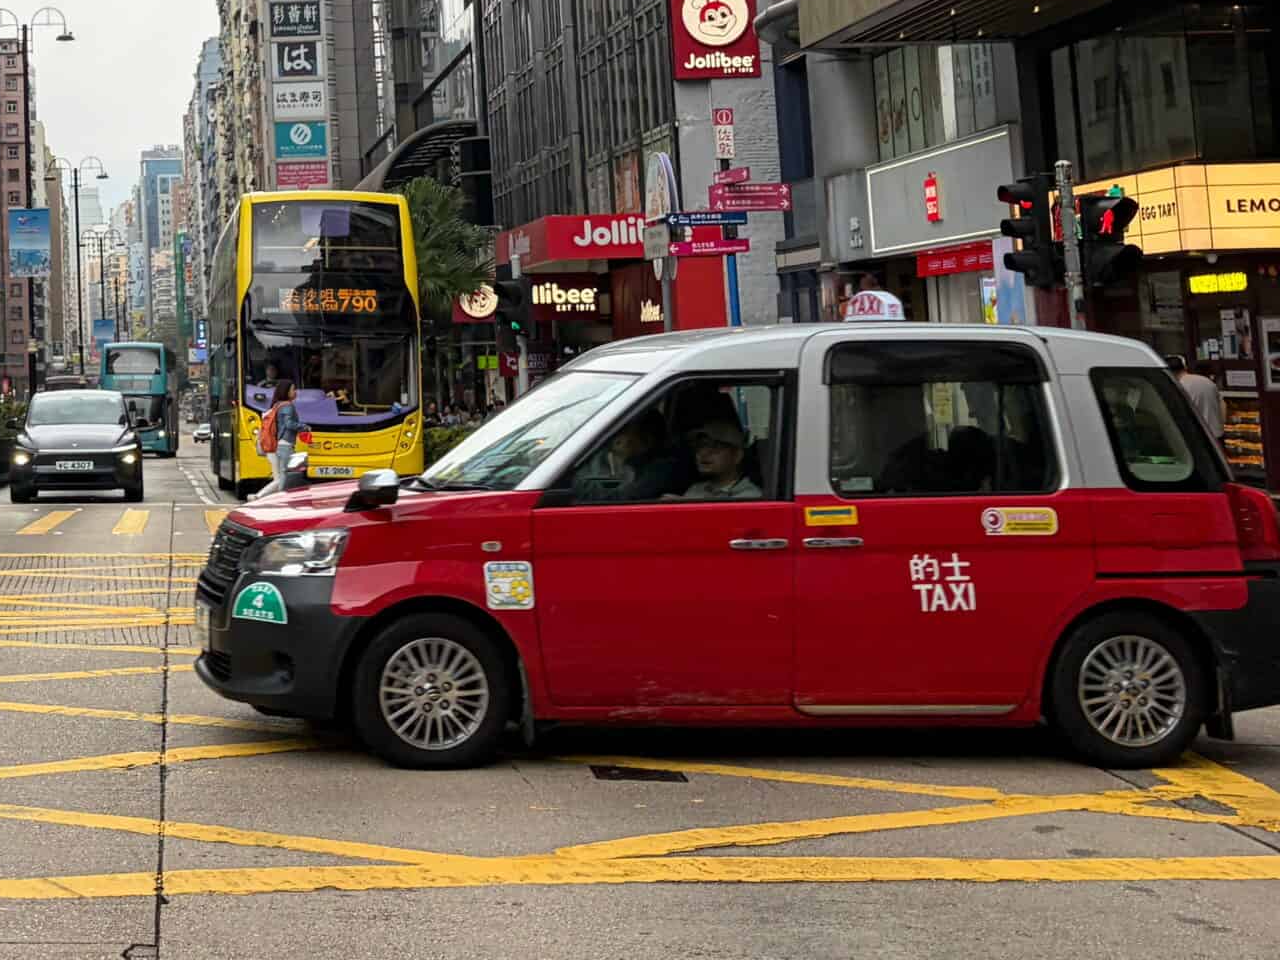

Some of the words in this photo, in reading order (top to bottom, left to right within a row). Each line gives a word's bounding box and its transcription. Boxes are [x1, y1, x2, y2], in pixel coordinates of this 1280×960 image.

[283, 44, 313, 73] は
[684, 51, 752, 69] Jollibee
[1141, 206, 1157, 221] EGG
[1158, 201, 1177, 218] TART
[1226, 197, 1280, 213] LEMO
[531, 282, 595, 305] llibee
[338, 296, 378, 313] 790
[850, 293, 884, 316] TAXI
[909, 552, 970, 581] 的士
[252, 593, 265, 609] 4
[912, 583, 977, 612] TAXI
